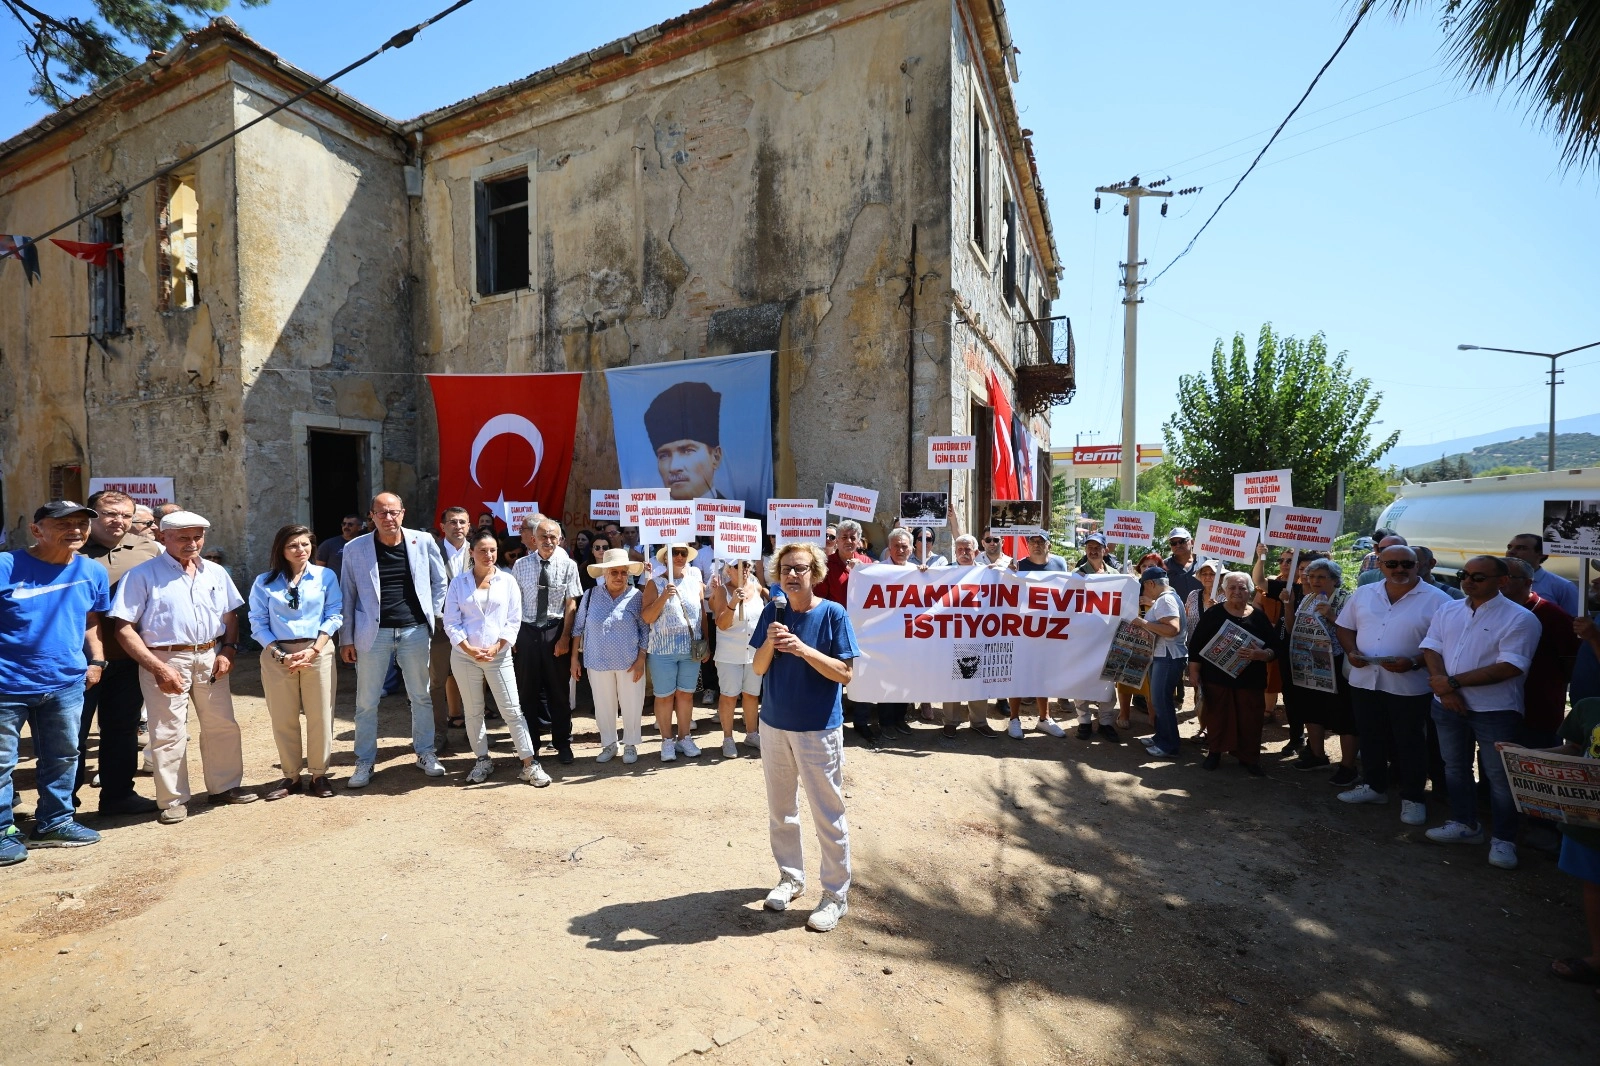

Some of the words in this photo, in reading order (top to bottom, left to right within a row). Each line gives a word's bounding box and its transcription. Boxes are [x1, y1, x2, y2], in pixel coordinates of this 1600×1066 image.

[932, 441, 960, 451] ATATÜRK
[960, 440, 972, 451] EVİ
[935, 453, 949, 465] İÇİN
[950, 454, 957, 463] EL
[957, 454, 968, 463] ELE
[1074, 451, 1139, 462] term
[1245, 475, 1279, 485] İNATLAŞMA
[1244, 487, 1259, 495] DEĞİL
[1260, 485, 1281, 495] ÇÖZÜM
[631, 493, 656, 501] 1937'DEN
[1247, 495, 1277, 504] İSTİYORUZ
[642, 506, 661, 515] KÜLTÜR
[645, 517, 671, 526] GÖREVİNİ
[671, 516, 690, 525] YERİNE
[780, 517, 802, 526] ATATÜRK
[1286, 514, 1311, 523] ATATÜRK
[1312, 516, 1322, 524] EVİ
[781, 528, 799, 537] SAHİBİ
[800, 529, 821, 537] HALKTIR
[1209, 525, 1223, 533] EFES
[1223, 528, 1246, 538] SELÇUK
[1209, 535, 1241, 547] MİRASINA
[1269, 531, 1296, 540] GELECEĞE
[1297, 534, 1331, 544] BIRAKILSIN
[1201, 543, 1219, 553] SAHİP
[1219, 547, 1245, 558] ÇIKIYOR
[863, 584, 1019, 609] ATAMIZ'IN
[1027, 586, 1122, 617] EVİNİ
[903, 613, 1070, 640] İSTİYORUZ
[1535, 764, 1585, 780] NEFES
